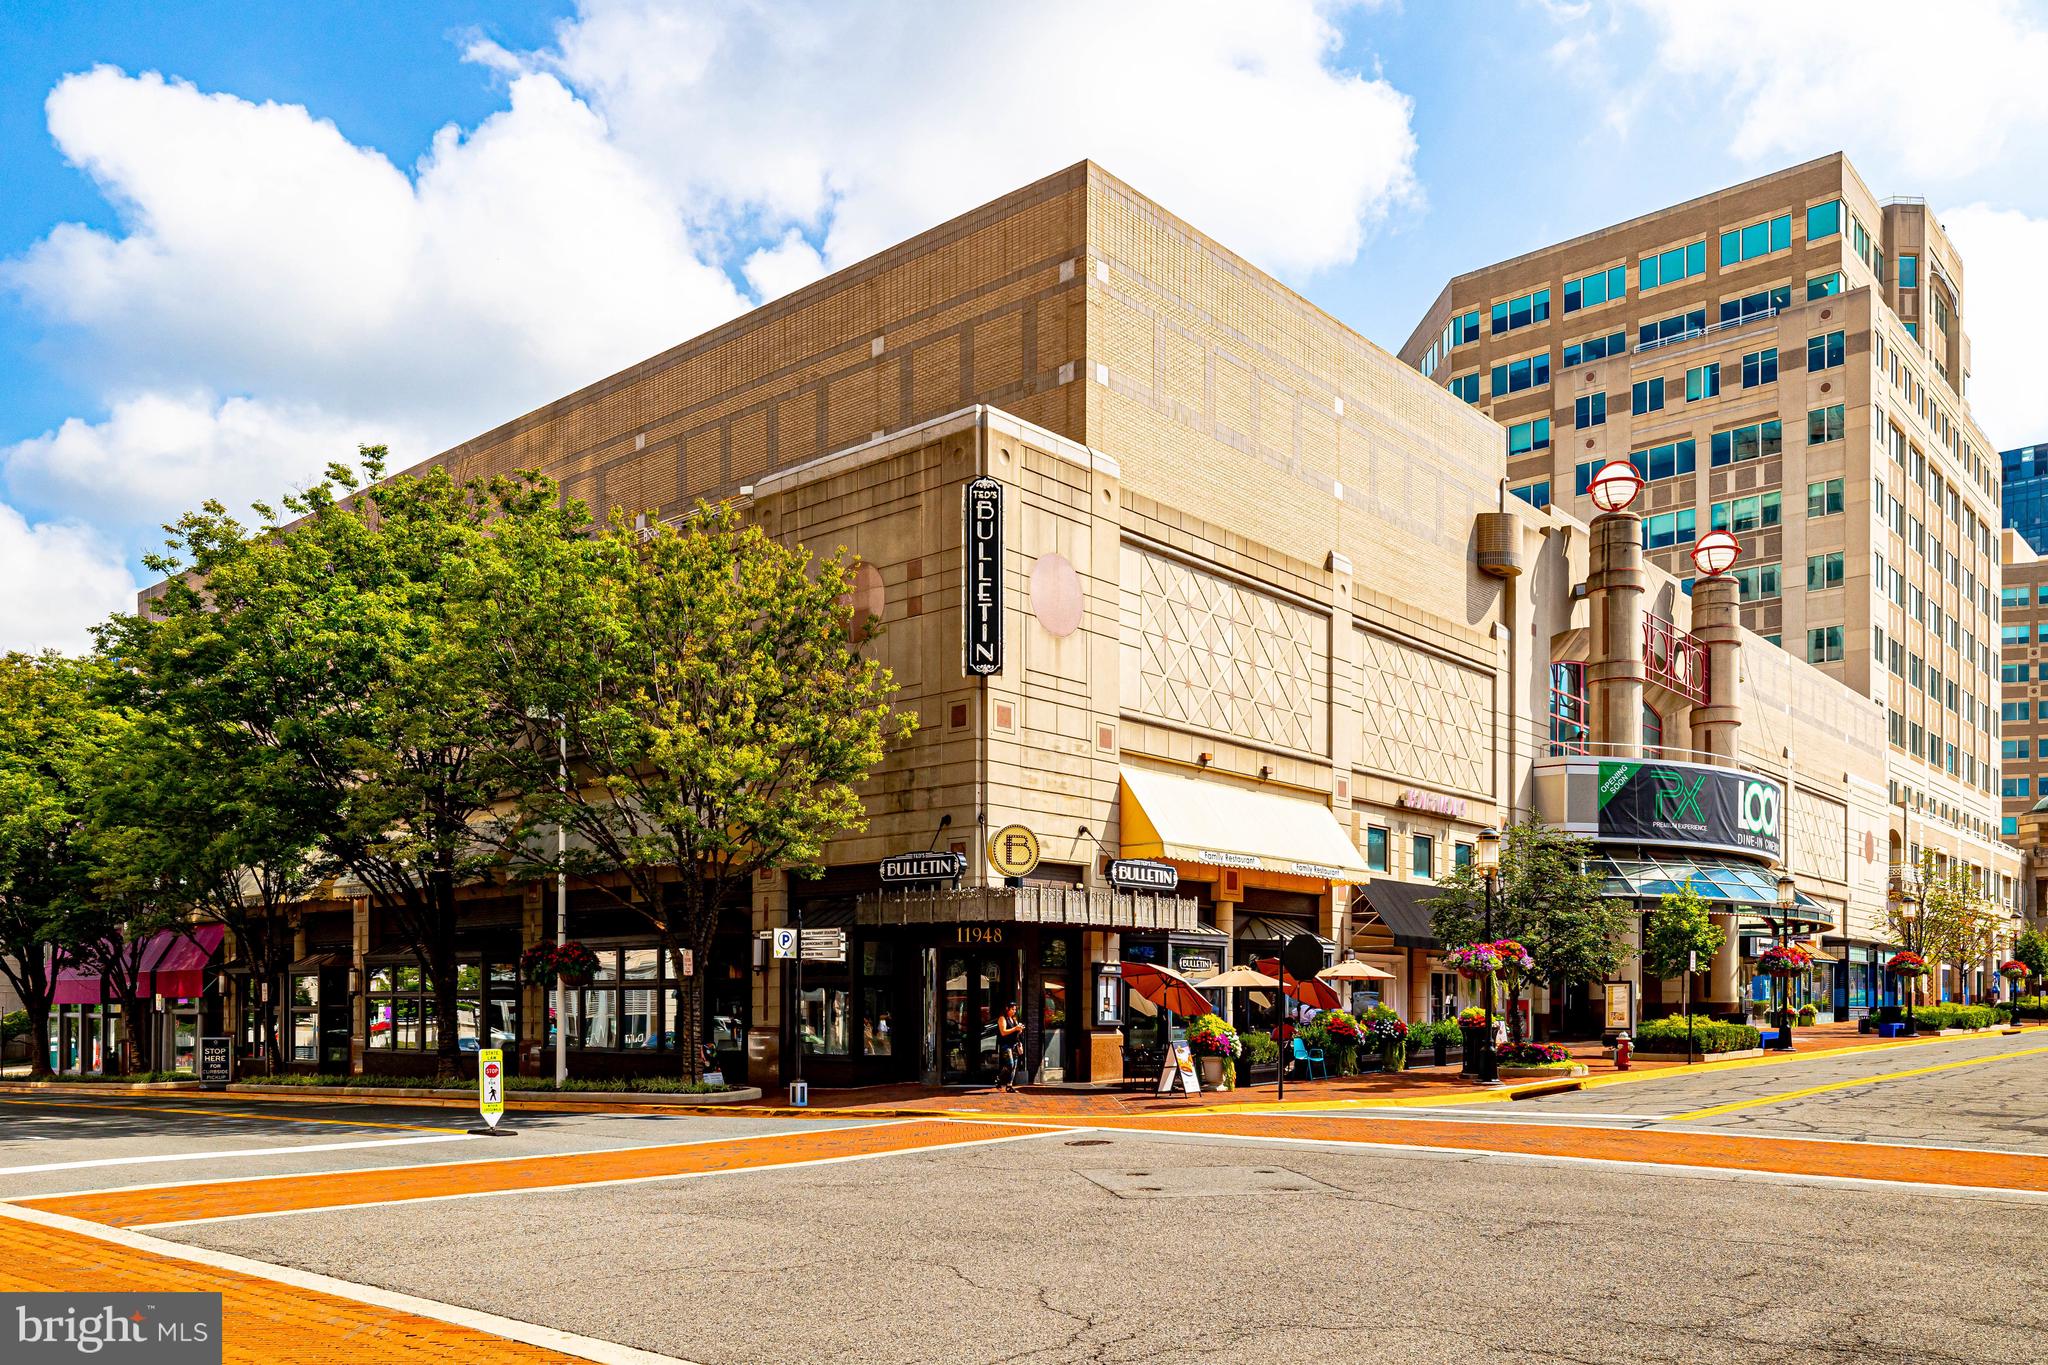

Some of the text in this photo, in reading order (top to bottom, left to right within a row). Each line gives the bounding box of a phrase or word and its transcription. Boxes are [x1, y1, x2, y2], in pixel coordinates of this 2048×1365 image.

[973, 490, 997, 499] TED'S
[976, 501, 995, 662] BULLETIN
[1600, 764, 1628, 793] OPENING
[1610, 775, 1629, 795] SOON
[1737, 780, 1780, 840] LOOK
[1678, 823, 1708, 832] EXPERIENCE
[1737, 833, 1763, 849] DINE-IN
[1204, 851, 1255, 865] Family Restaurant
[886, 860, 952, 877] BULLETIN
[1118, 865, 1173, 884] BULLETIN
[1296, 863, 1340, 877] Family Restaurant
[782, 934, 790, 946] P
[956, 927, 1002, 943] 11948
[1182, 959, 1209, 968] BULLETIN
